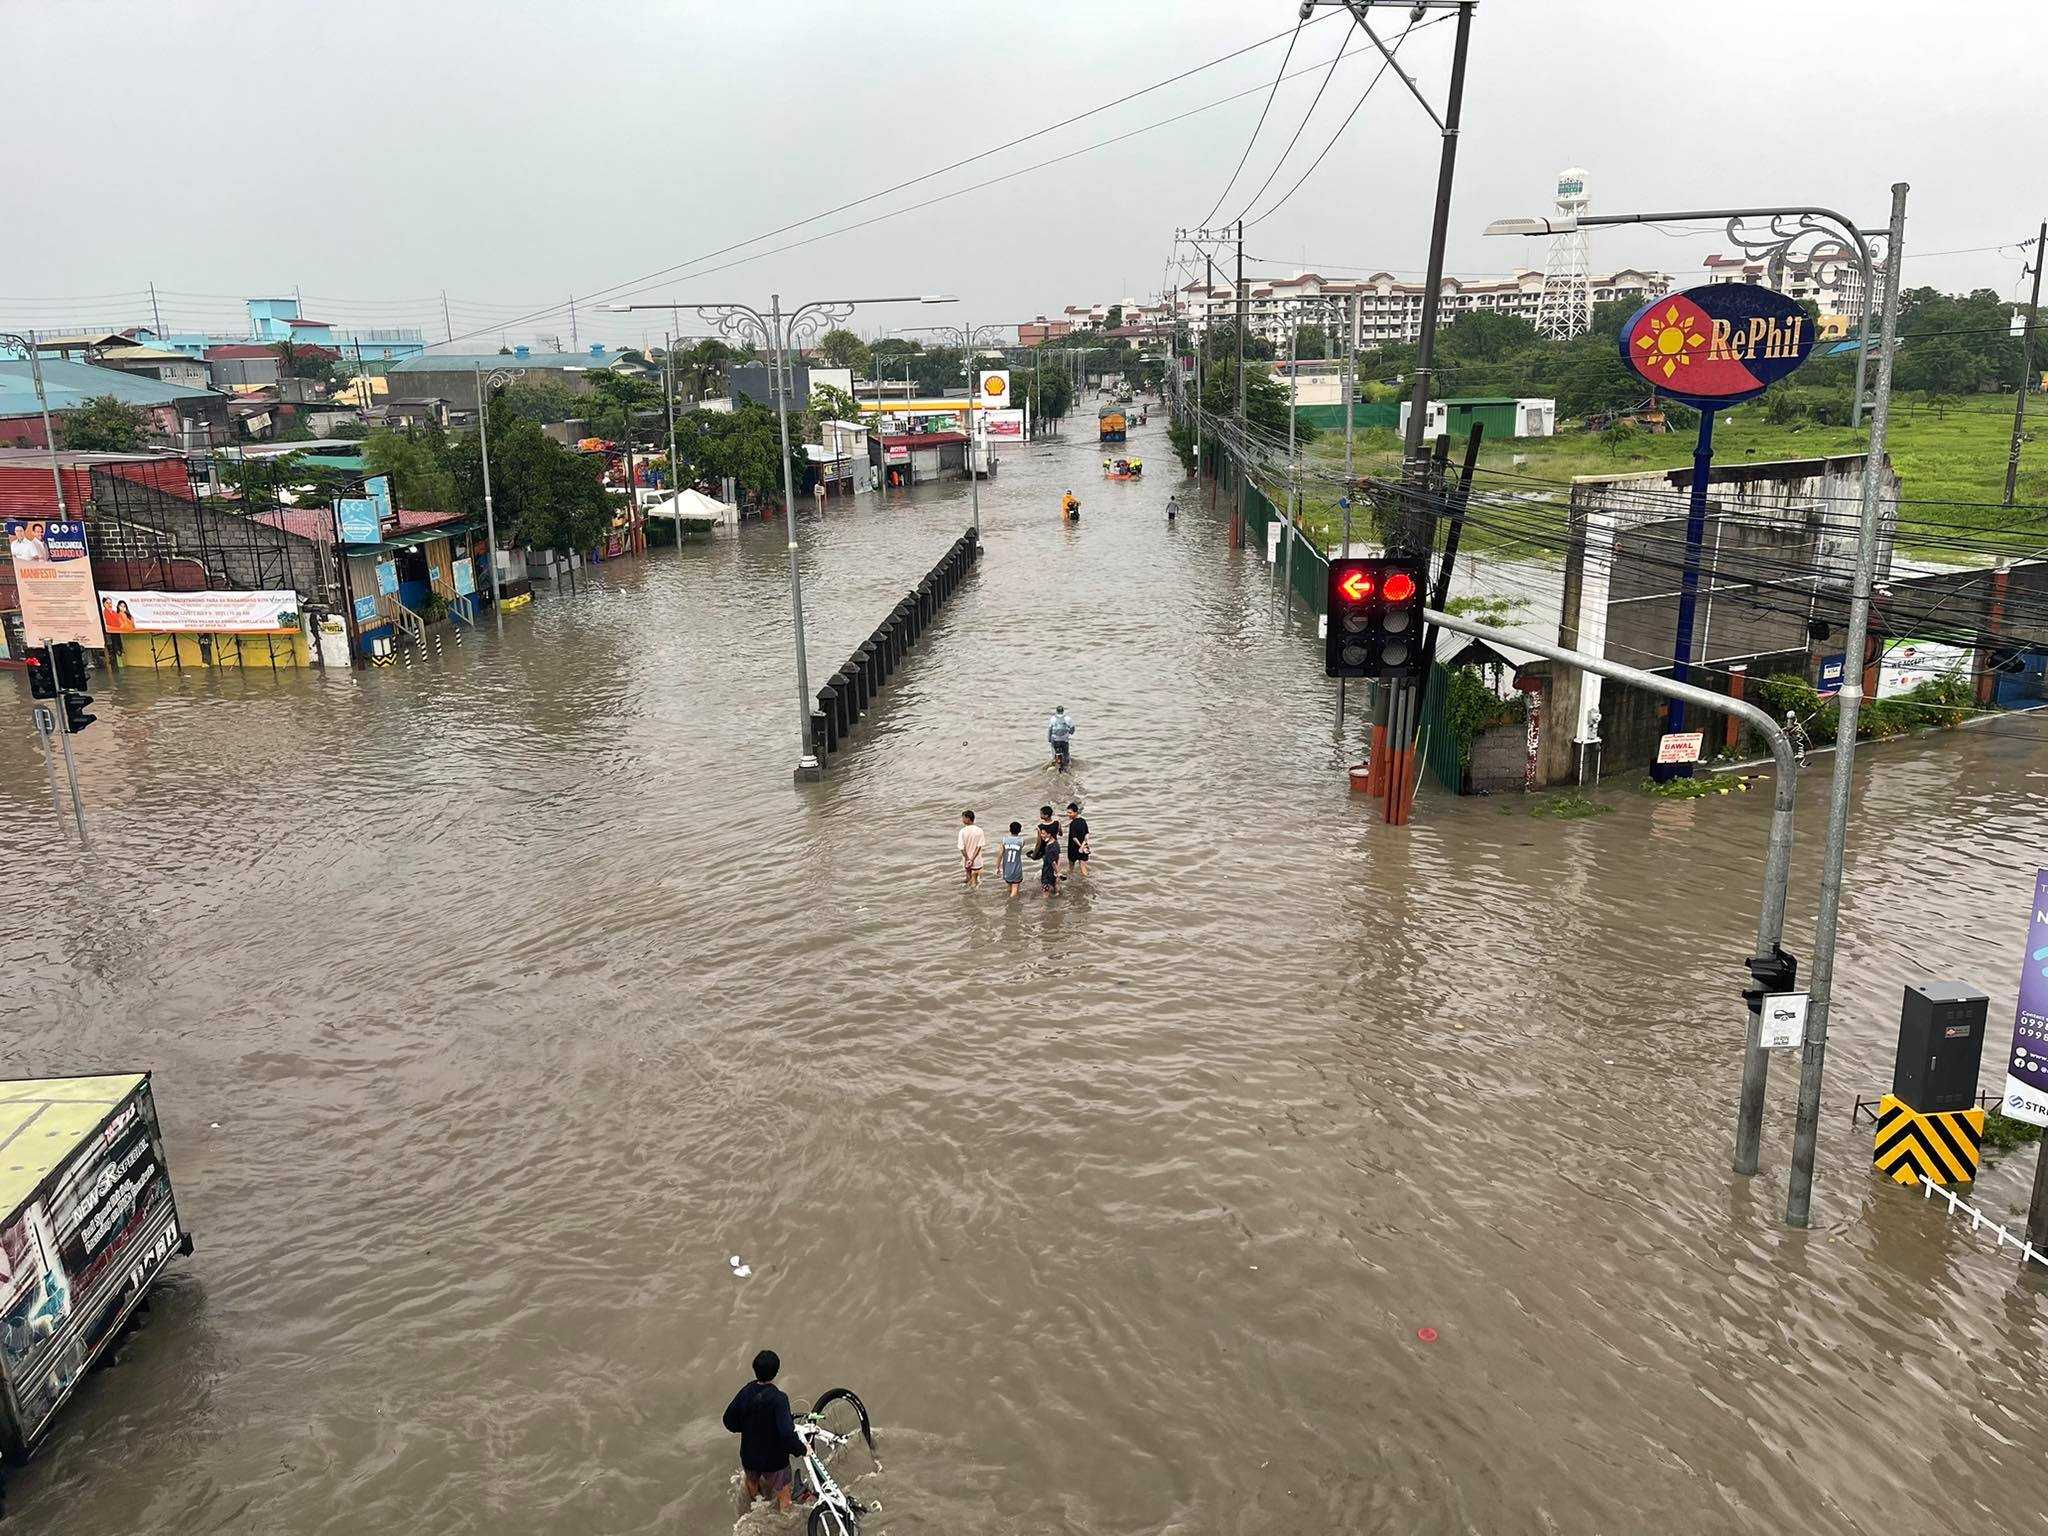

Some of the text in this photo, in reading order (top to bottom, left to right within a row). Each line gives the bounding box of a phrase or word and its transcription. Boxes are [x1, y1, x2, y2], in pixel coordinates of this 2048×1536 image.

[1706, 315, 1803, 361] RePhil
[20, 567, 57, 579] MANIFESTO
[1007, 850, 1016, 863] 11
[2021, 1010, 2045, 1020] Contact
[71, 1186, 99, 1228] NEW
